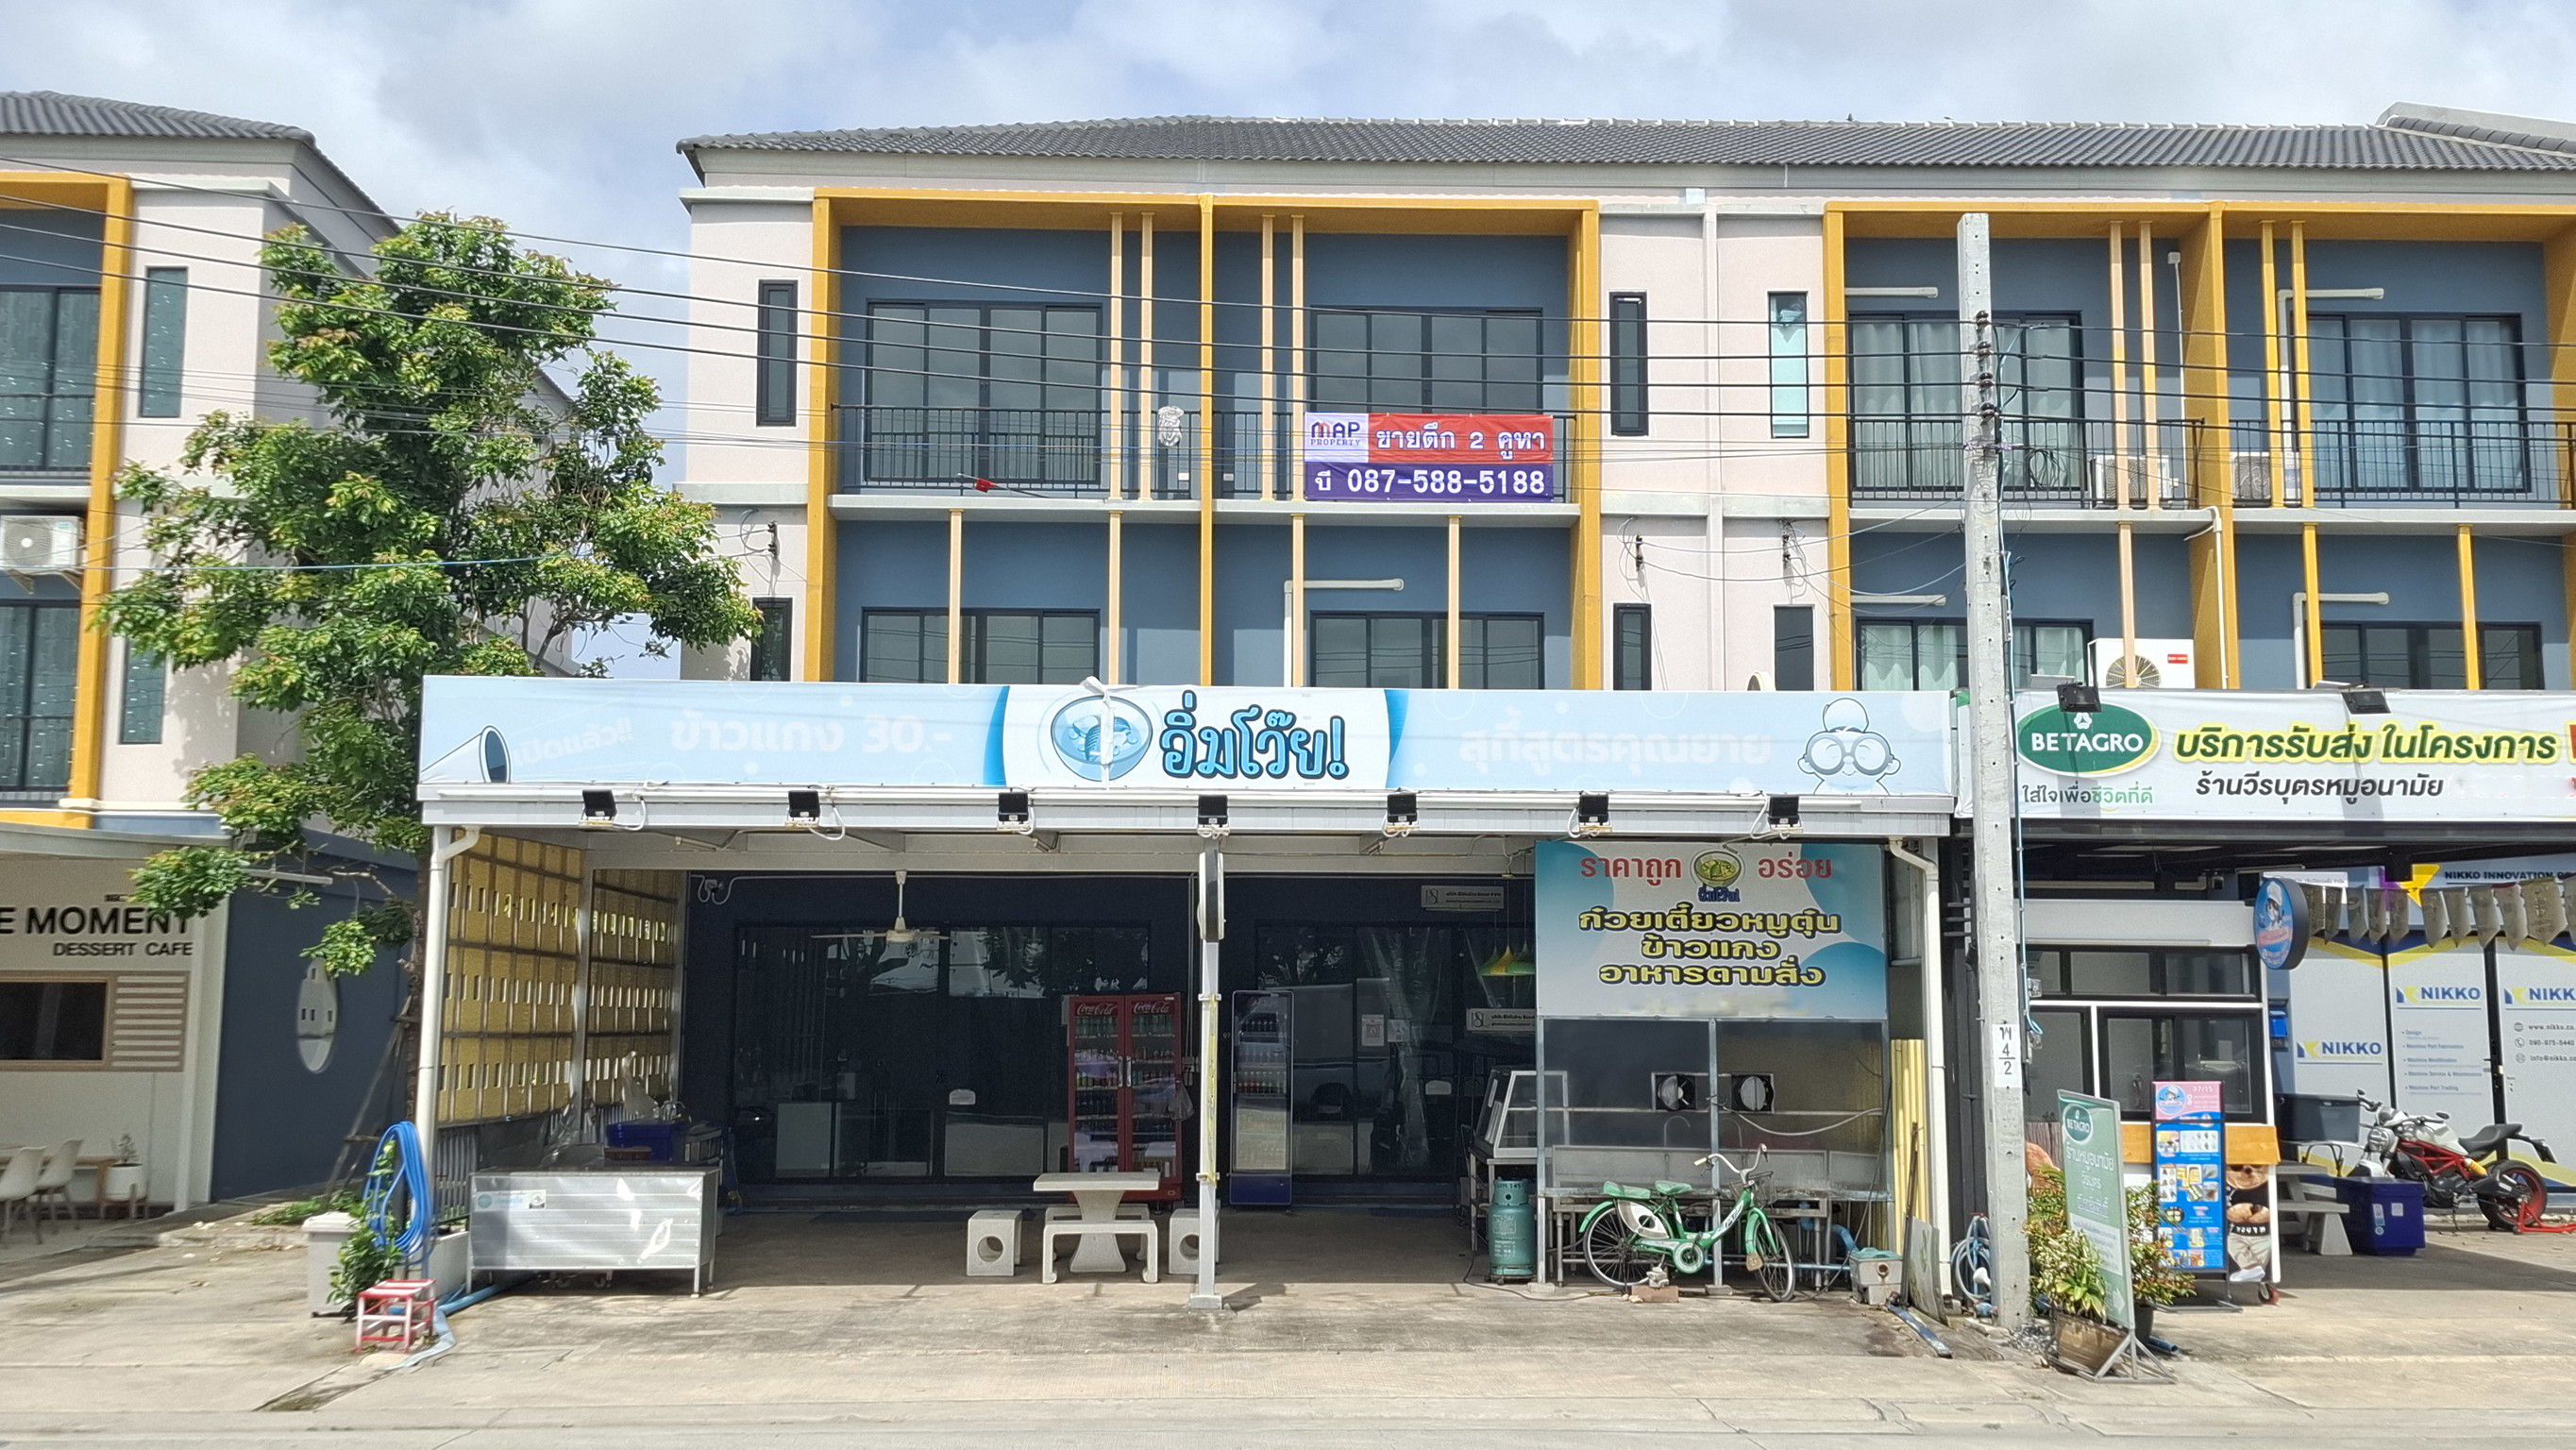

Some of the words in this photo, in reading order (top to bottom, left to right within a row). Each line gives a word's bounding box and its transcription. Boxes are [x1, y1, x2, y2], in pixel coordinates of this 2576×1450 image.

[1311, 421, 1360, 438] MAP
[1309, 438, 1360, 447] PROPERTY
[1376, 422, 1456, 450] ขายตึก
[1470, 431, 1484, 450] 2
[1497, 430, 1545, 461] คูหา
[1315, 470, 1332, 492] บี
[1347, 468, 1545, 494] 087-588-5188
[671, 709, 844, 752] ข้าวแกง
[2030, 733, 2144, 753] BETAGRO
[2177, 723, 2372, 759] บริการรับส่ง
[2382, 723, 2557, 759] ในโครงการ
[1579, 856, 1682, 886] ราคาถูก
[1758, 851, 1833, 880] อร่อย
[53, 942, 137, 956] DESSERT
[145, 942, 194, 956] CAFE
[1641, 933, 1781, 960] ข้าวแกง
[1599, 955, 1826, 986] อาหารตามสั่ง
[2421, 986, 2481, 1000] NIKKO
[2002, 1042, 2011, 1056] 4
[2322, 1041, 2382, 1055] NIKKO
[2004, 1060, 2012, 1074] 2
